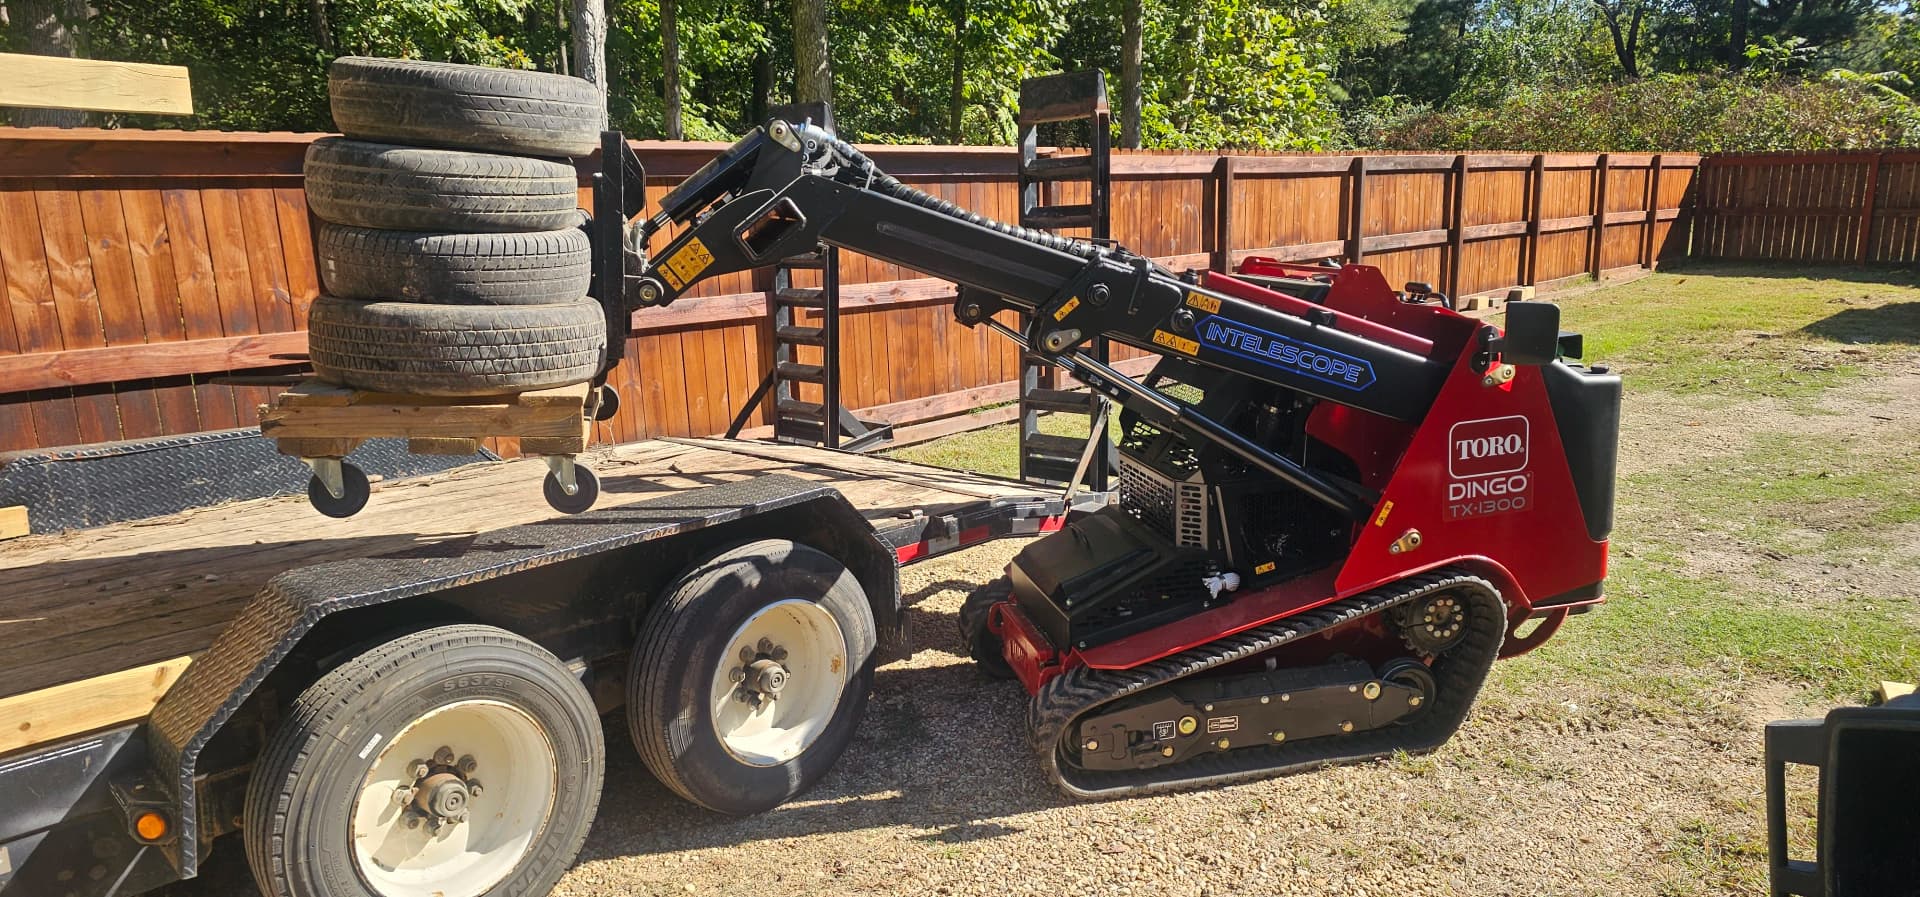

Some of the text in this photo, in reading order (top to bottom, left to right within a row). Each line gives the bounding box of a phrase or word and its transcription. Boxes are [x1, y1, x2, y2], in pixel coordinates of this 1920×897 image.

[1206, 322, 1363, 383] INTELESCOPE
[1456, 433, 1522, 460] TORO
[1448, 475, 1527, 501] DINGO
[442, 674, 513, 692] S637 SP
